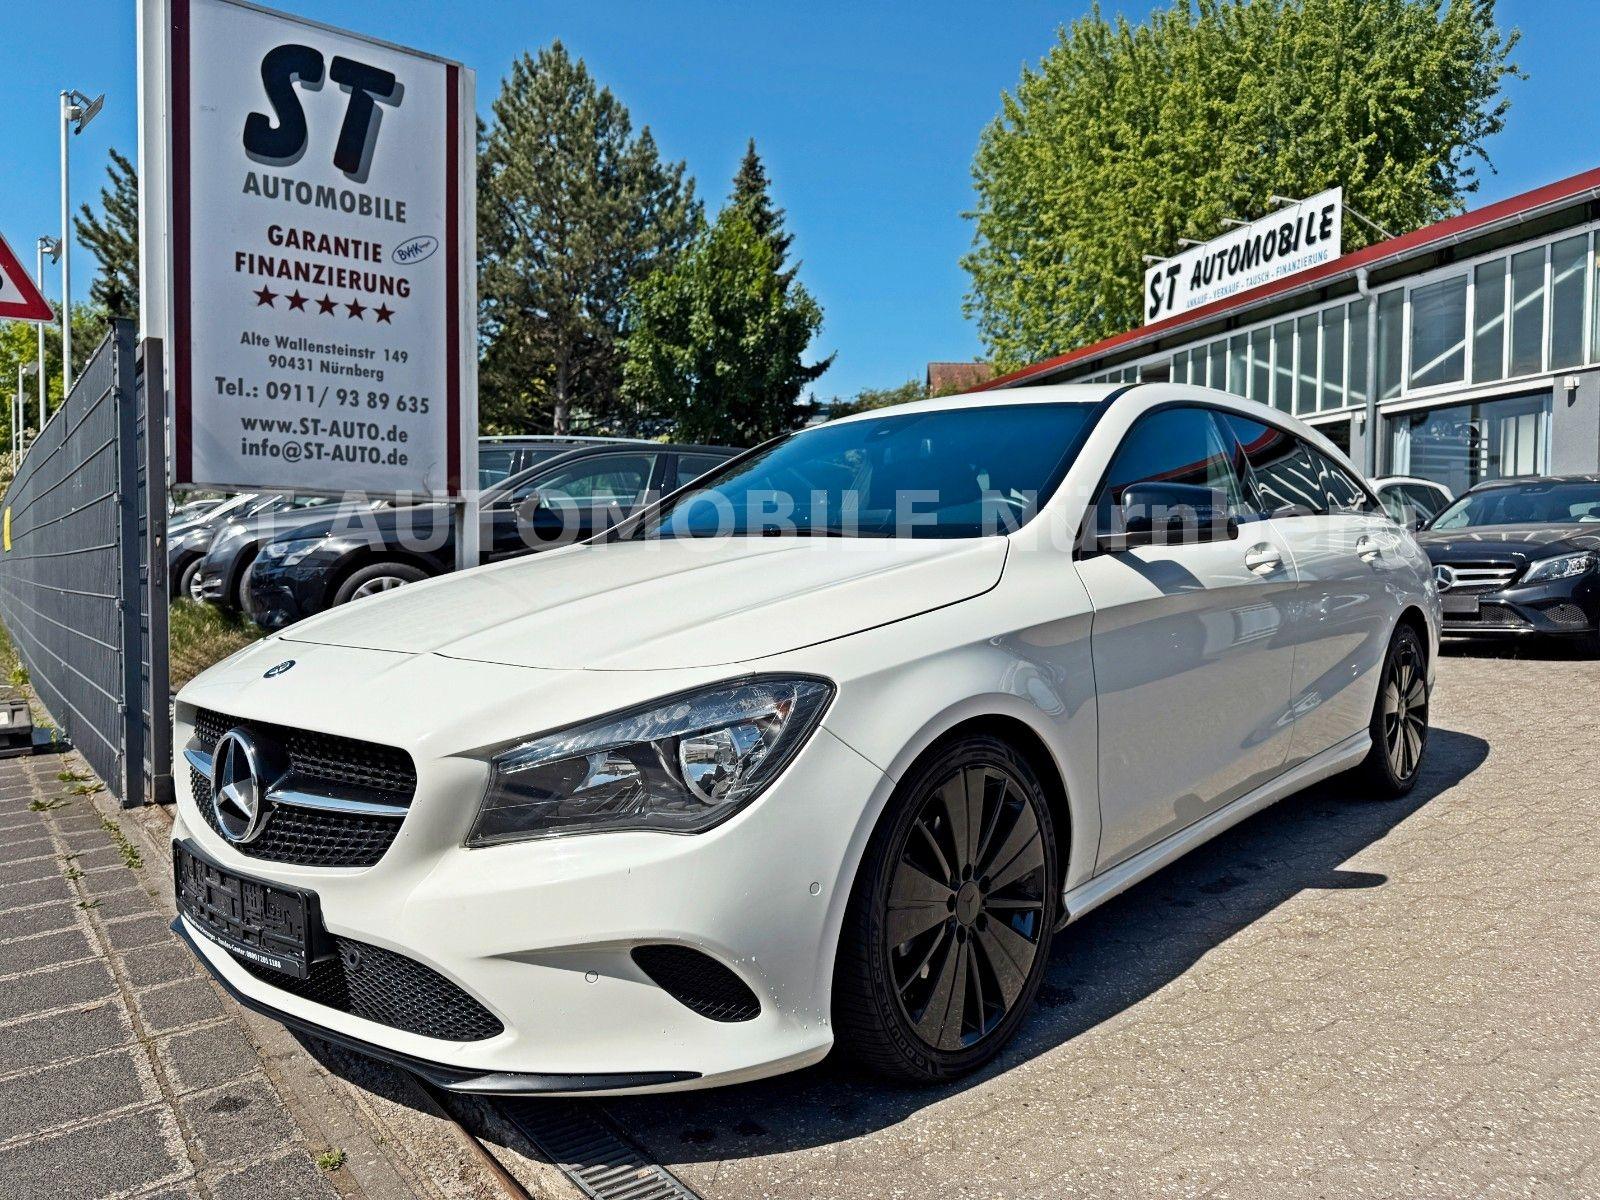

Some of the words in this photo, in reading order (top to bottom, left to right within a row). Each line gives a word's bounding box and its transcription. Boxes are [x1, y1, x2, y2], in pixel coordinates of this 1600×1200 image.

[243, 44, 403, 183] ST
[242, 172, 407, 223] AUTOMOBILE
[268, 225, 382, 262] GARANTIE
[1149, 264, 1181, 319] ST
[1190, 203, 1335, 291] AUTOMOBILE
[235, 252, 410, 297] FINANZIERUNG
[1213, 281, 1239, 298] VERKAUF
[1246, 271, 1269, 287] TAUSCH
[1276, 249, 1328, 274] FINANZIERUNG
[240, 331, 270, 347] Alte
[275, 335, 376, 360] Wallensteinstr
[383, 349, 408, 363] 149
[268, 354, 313, 371] 90431
[320, 360, 384, 382] Nürnberg
[215, 376, 258, 397] Tel.:
[336, 388, 360, 407] 93
[367, 391, 390, 410] 89
[396, 395, 429, 414] 635
[241, 417, 408, 443] www.ST-AUTO.de
[241, 437, 408, 466] info@ST-AUTO.de
